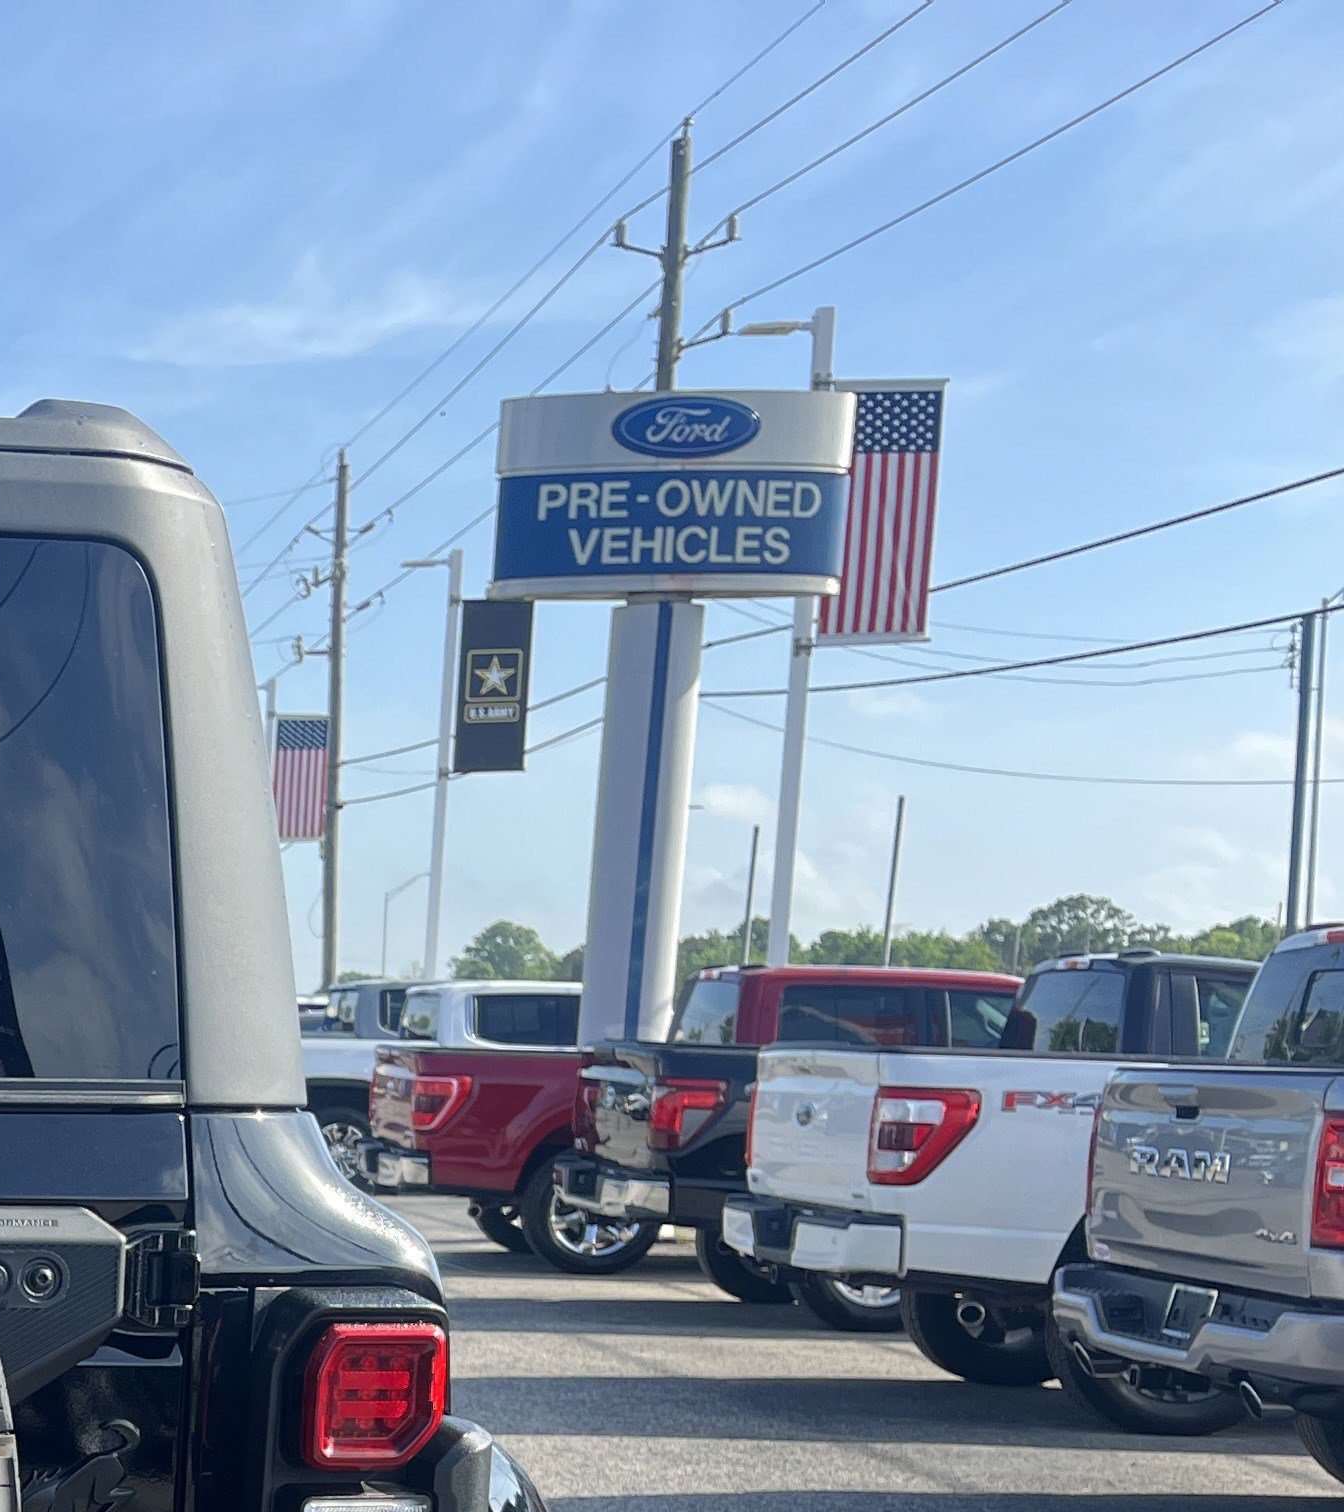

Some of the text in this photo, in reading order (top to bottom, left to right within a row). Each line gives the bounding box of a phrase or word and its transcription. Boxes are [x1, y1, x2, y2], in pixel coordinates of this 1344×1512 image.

[644, 404, 732, 444] Ford
[568, 525, 791, 566] VEHICLES
[1129, 1145, 1232, 1184] RAM
